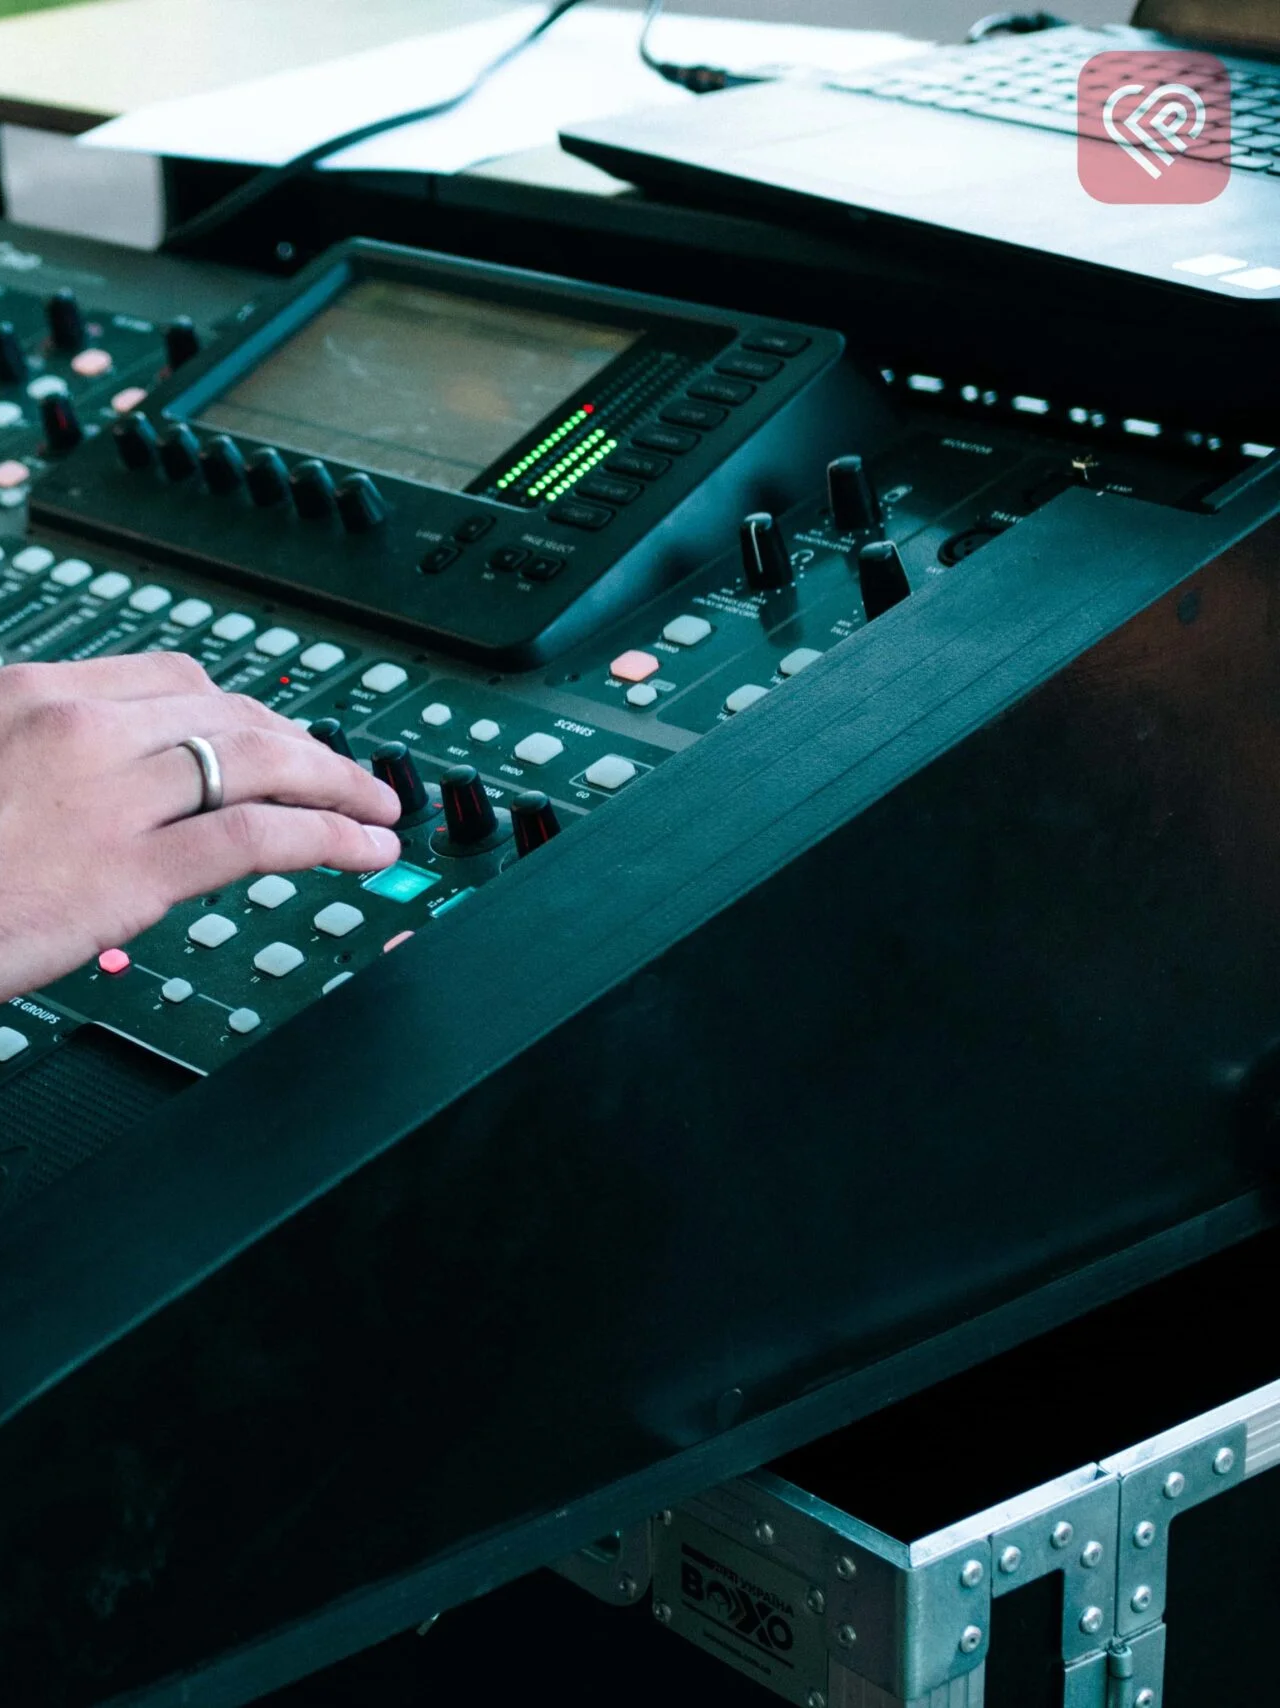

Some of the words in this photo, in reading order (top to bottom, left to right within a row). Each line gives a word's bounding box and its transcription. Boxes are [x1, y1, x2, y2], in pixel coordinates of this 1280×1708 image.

[554, 718, 596, 738] SCENES
[400, 729, 421, 741] PREV
[447, 745, 470, 758] NEXT
[499, 764, 524, 777] UNDO
[483, 785, 505, 799] IGN
[575, 790, 590, 800] GO
[8, 996, 24, 1007] TE
[20, 1001, 61, 1025] GROUPS
